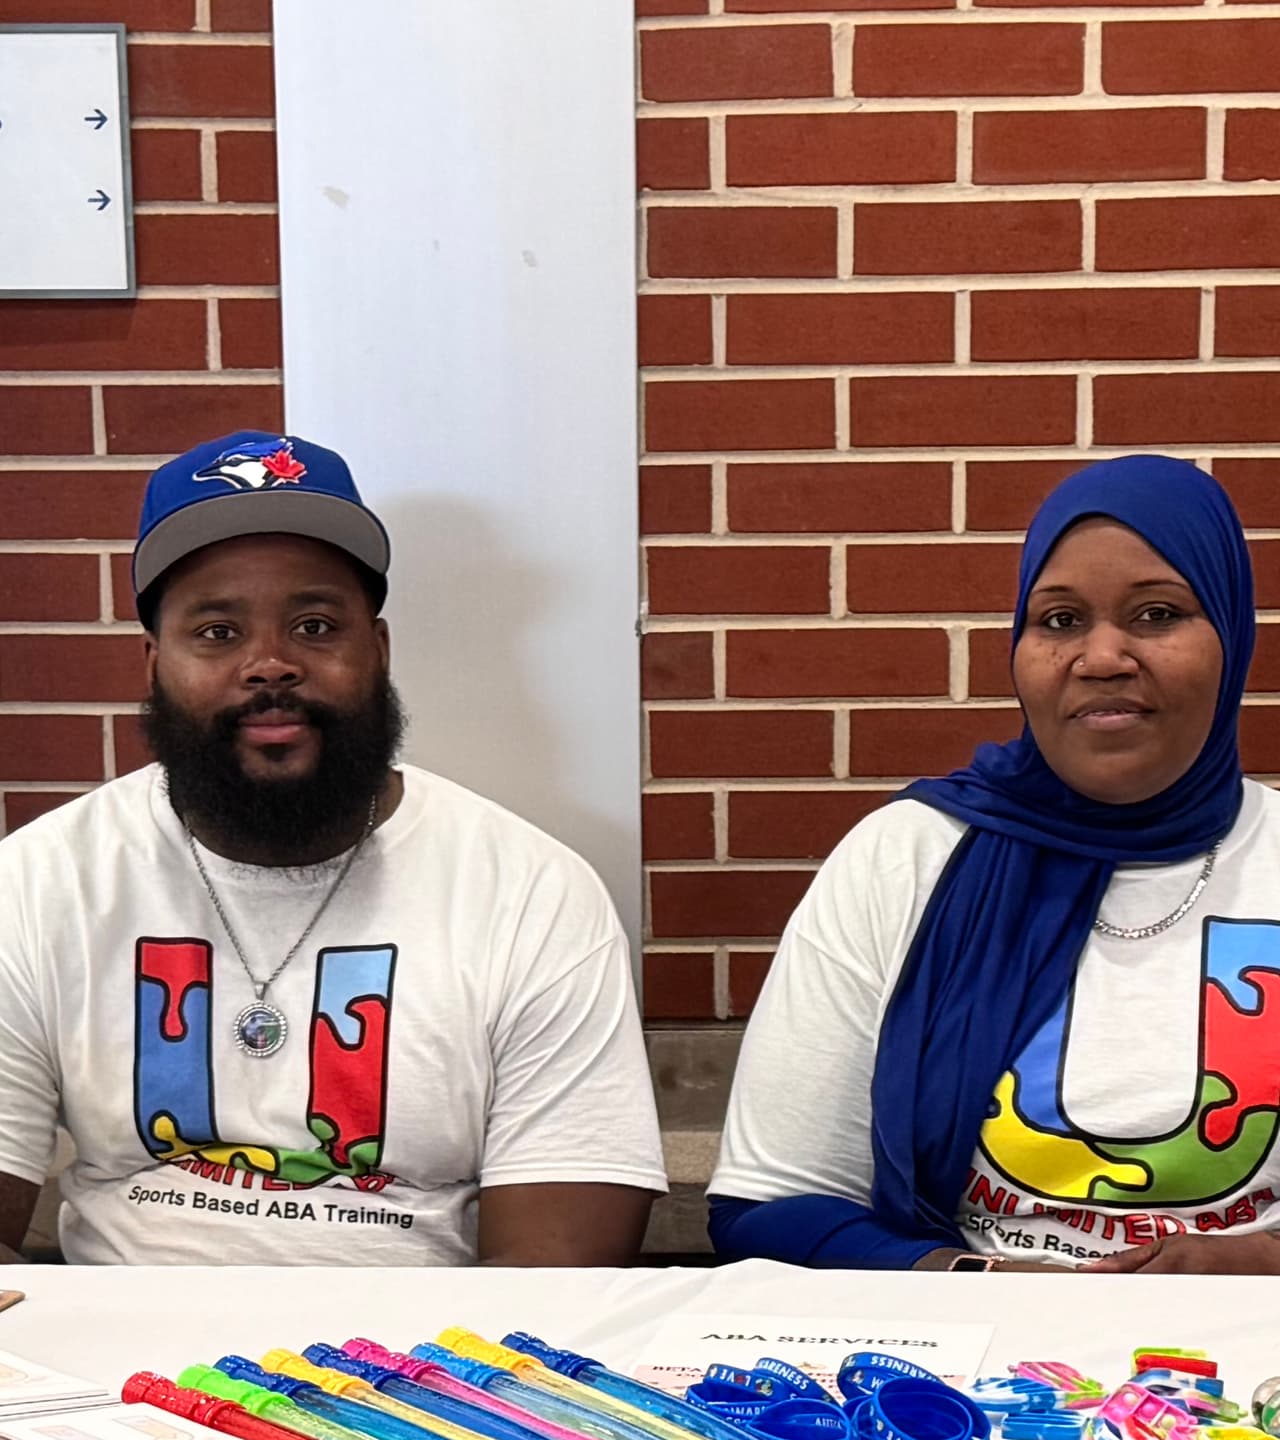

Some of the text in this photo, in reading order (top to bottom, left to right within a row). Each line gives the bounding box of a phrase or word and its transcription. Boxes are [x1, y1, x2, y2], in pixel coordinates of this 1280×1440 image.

[128, 1186, 414, 1229] Sports Based ABA Training
[1043, 1234, 1118, 1259] Base
[701, 1334, 938, 1347] ABA SERVICES
